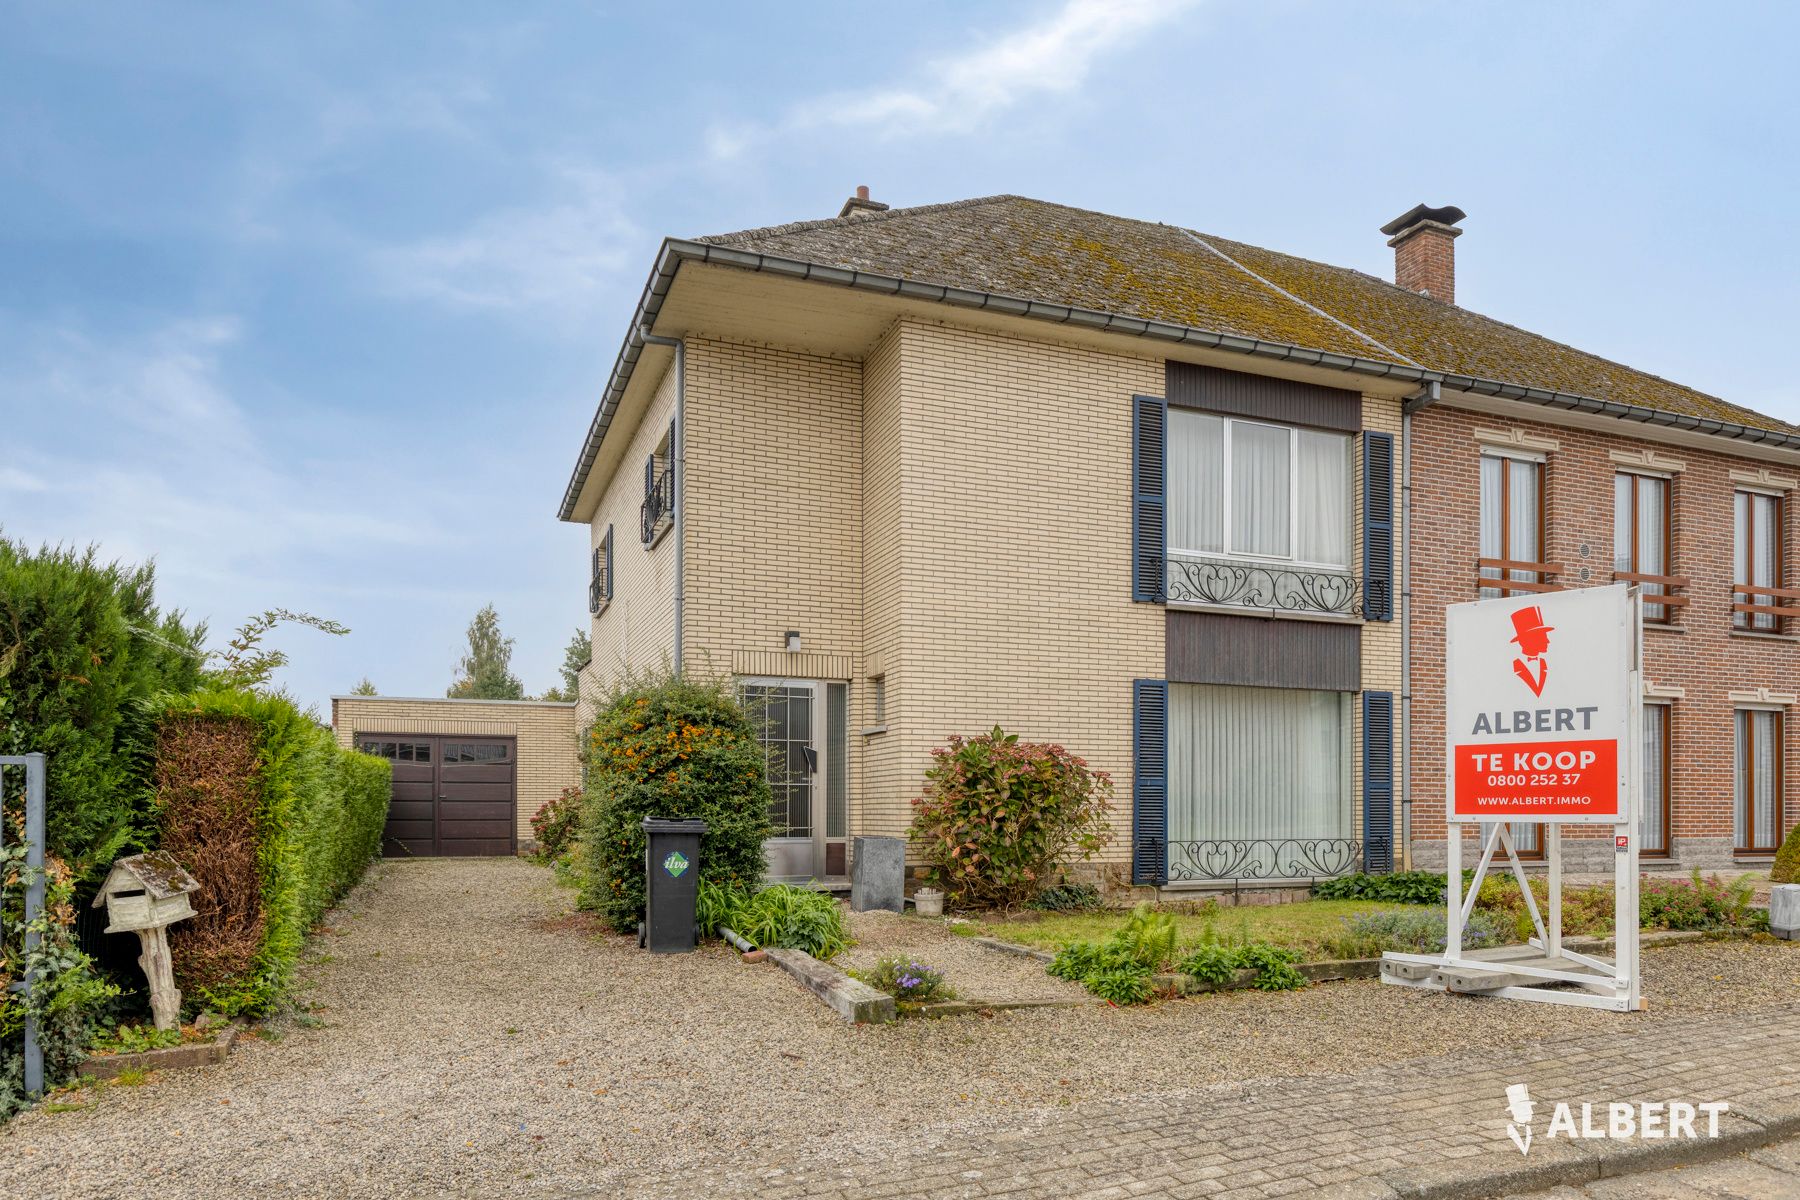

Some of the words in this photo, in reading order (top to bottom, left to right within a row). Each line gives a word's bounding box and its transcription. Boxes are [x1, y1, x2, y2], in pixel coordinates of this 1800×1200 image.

[1472, 707, 1598, 735] ALBERT
[1472, 754, 1503, 772] TE
[1513, 751, 1596, 771] KOOP
[1487, 775, 1526, 787] 0800
[1530, 774, 1558, 786] 252
[1562, 773, 1581, 785] 37
[1477, 796, 1591, 806] WWW.ALBERT.IMMO
[664, 856, 689, 869] ilva
